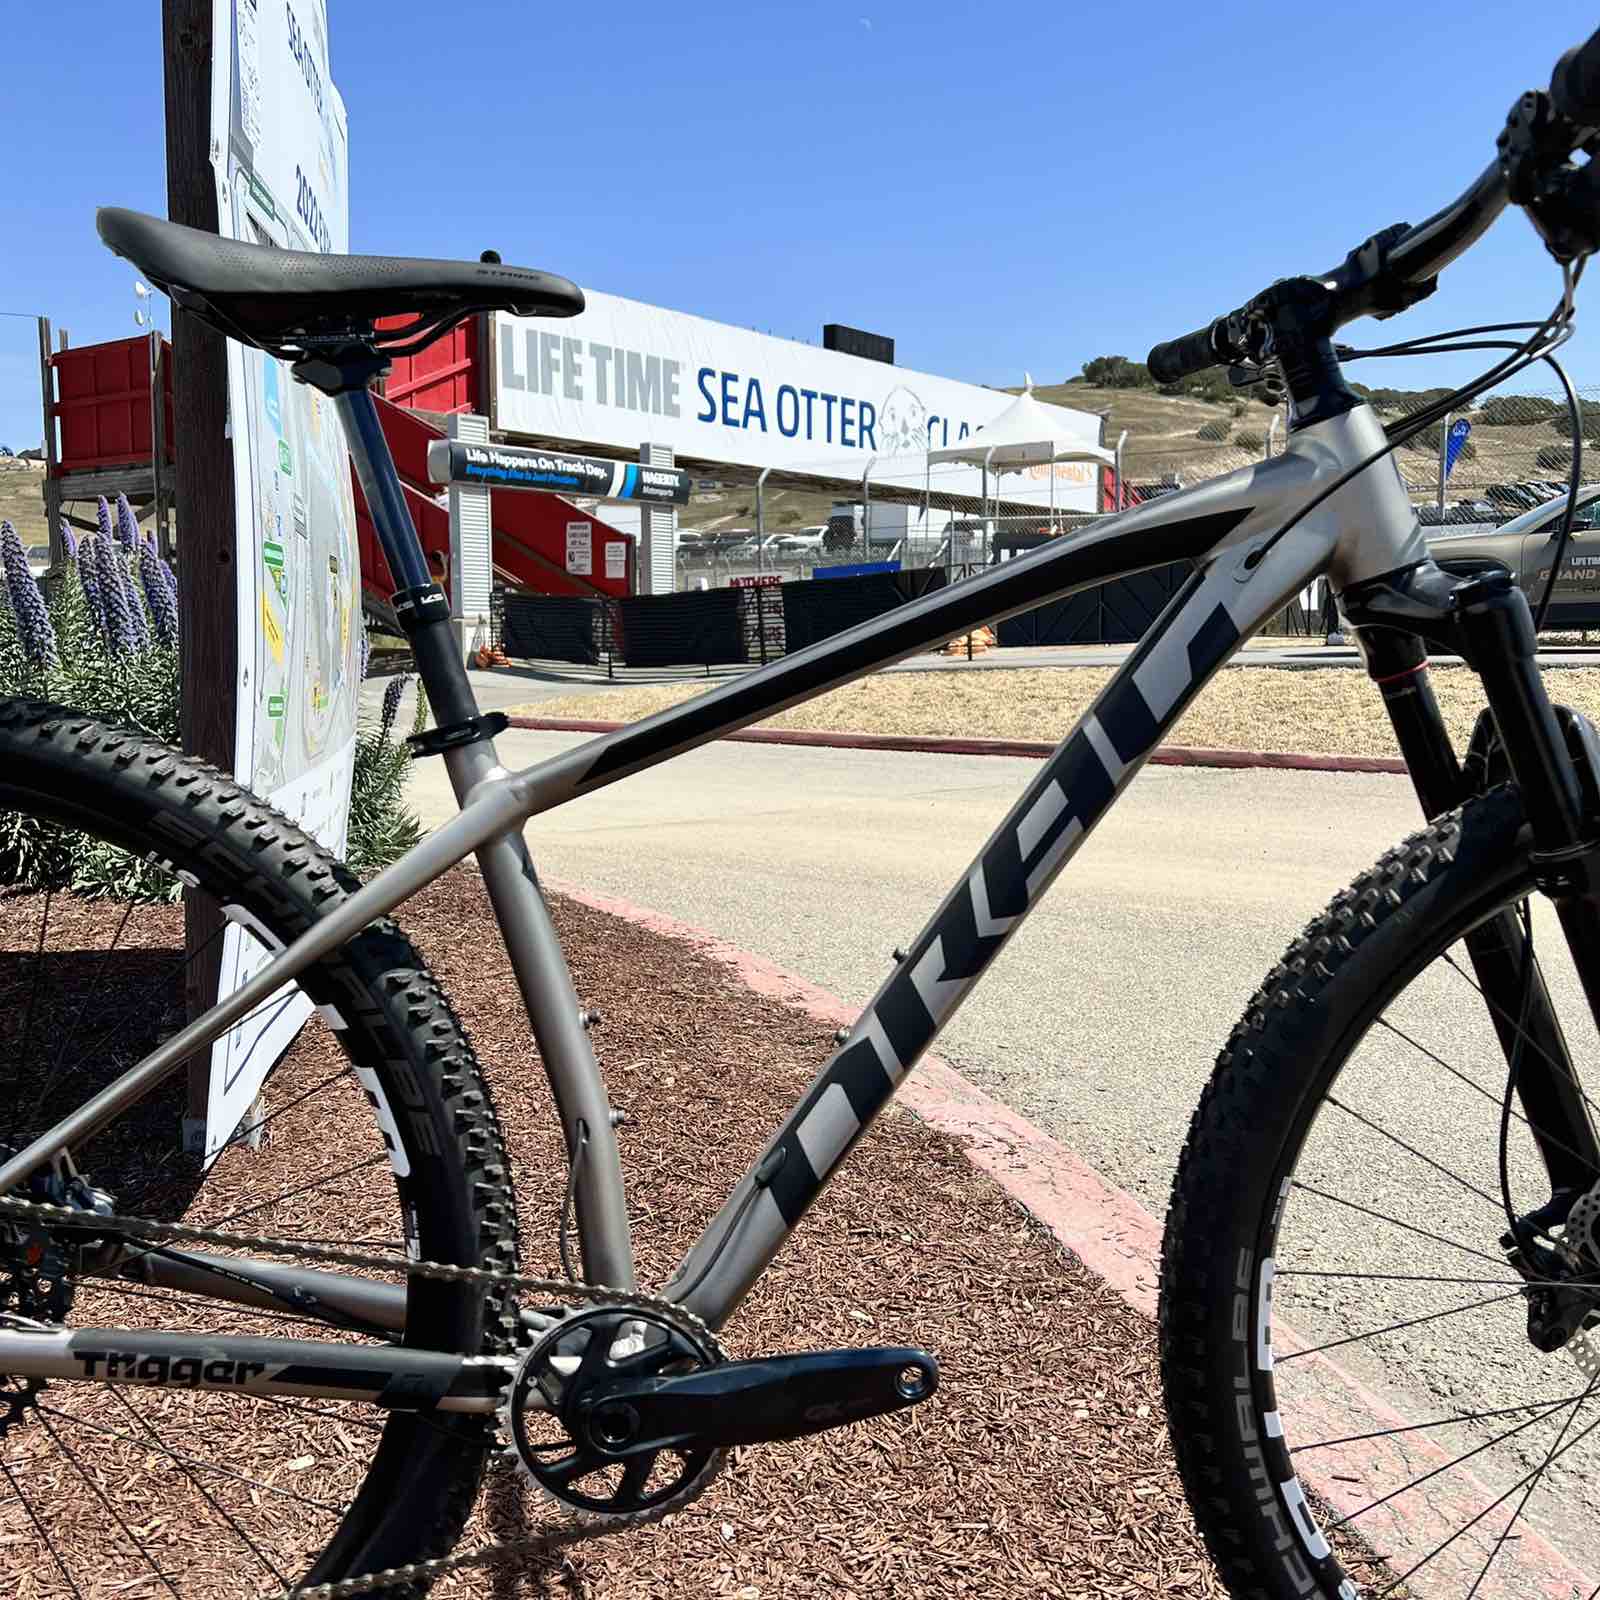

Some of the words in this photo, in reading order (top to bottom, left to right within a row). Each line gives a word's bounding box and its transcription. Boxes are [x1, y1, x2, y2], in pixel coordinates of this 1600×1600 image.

[295, 163, 318, 244] 2022
[499, 323, 584, 401] LIFE
[589, 342, 682, 420] TIME
[696, 366, 768, 433] SEA
[776, 384, 878, 451] OTTER
[465, 448, 488, 463] Life
[488, 451, 538, 469] Happens
[538, 457, 555, 470] On
[556, 458, 586, 474] Track
[73, 1350, 270, 1387] Trigger
